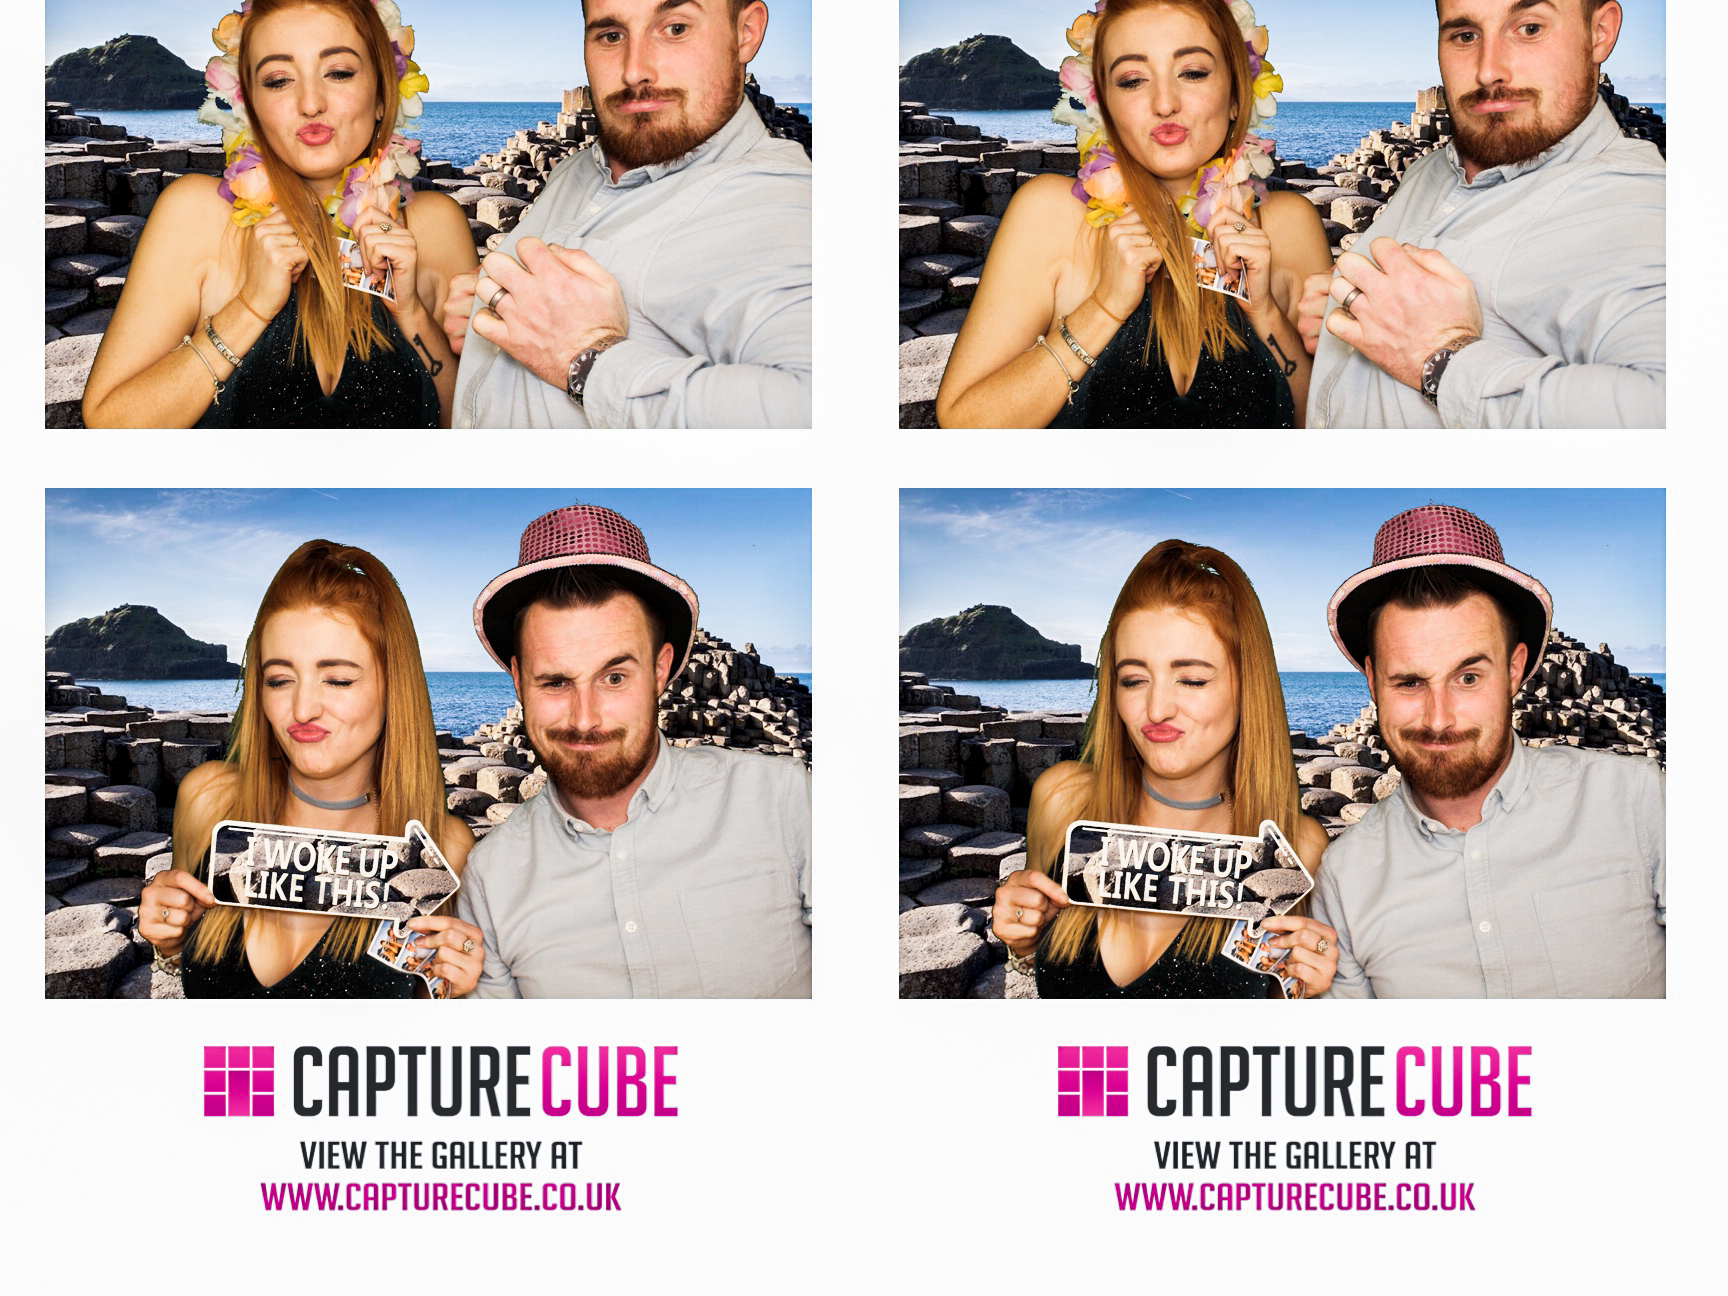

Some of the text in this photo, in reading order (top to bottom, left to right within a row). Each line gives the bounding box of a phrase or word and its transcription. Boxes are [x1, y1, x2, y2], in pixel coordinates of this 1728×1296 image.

[246, 836, 399, 880] I WOKE UP
[1100, 836, 1253, 880] I WOKE UP
[245, 869, 391, 910] LIKE THIS!
[1099, 869, 1245, 910] LIKE THIS!
